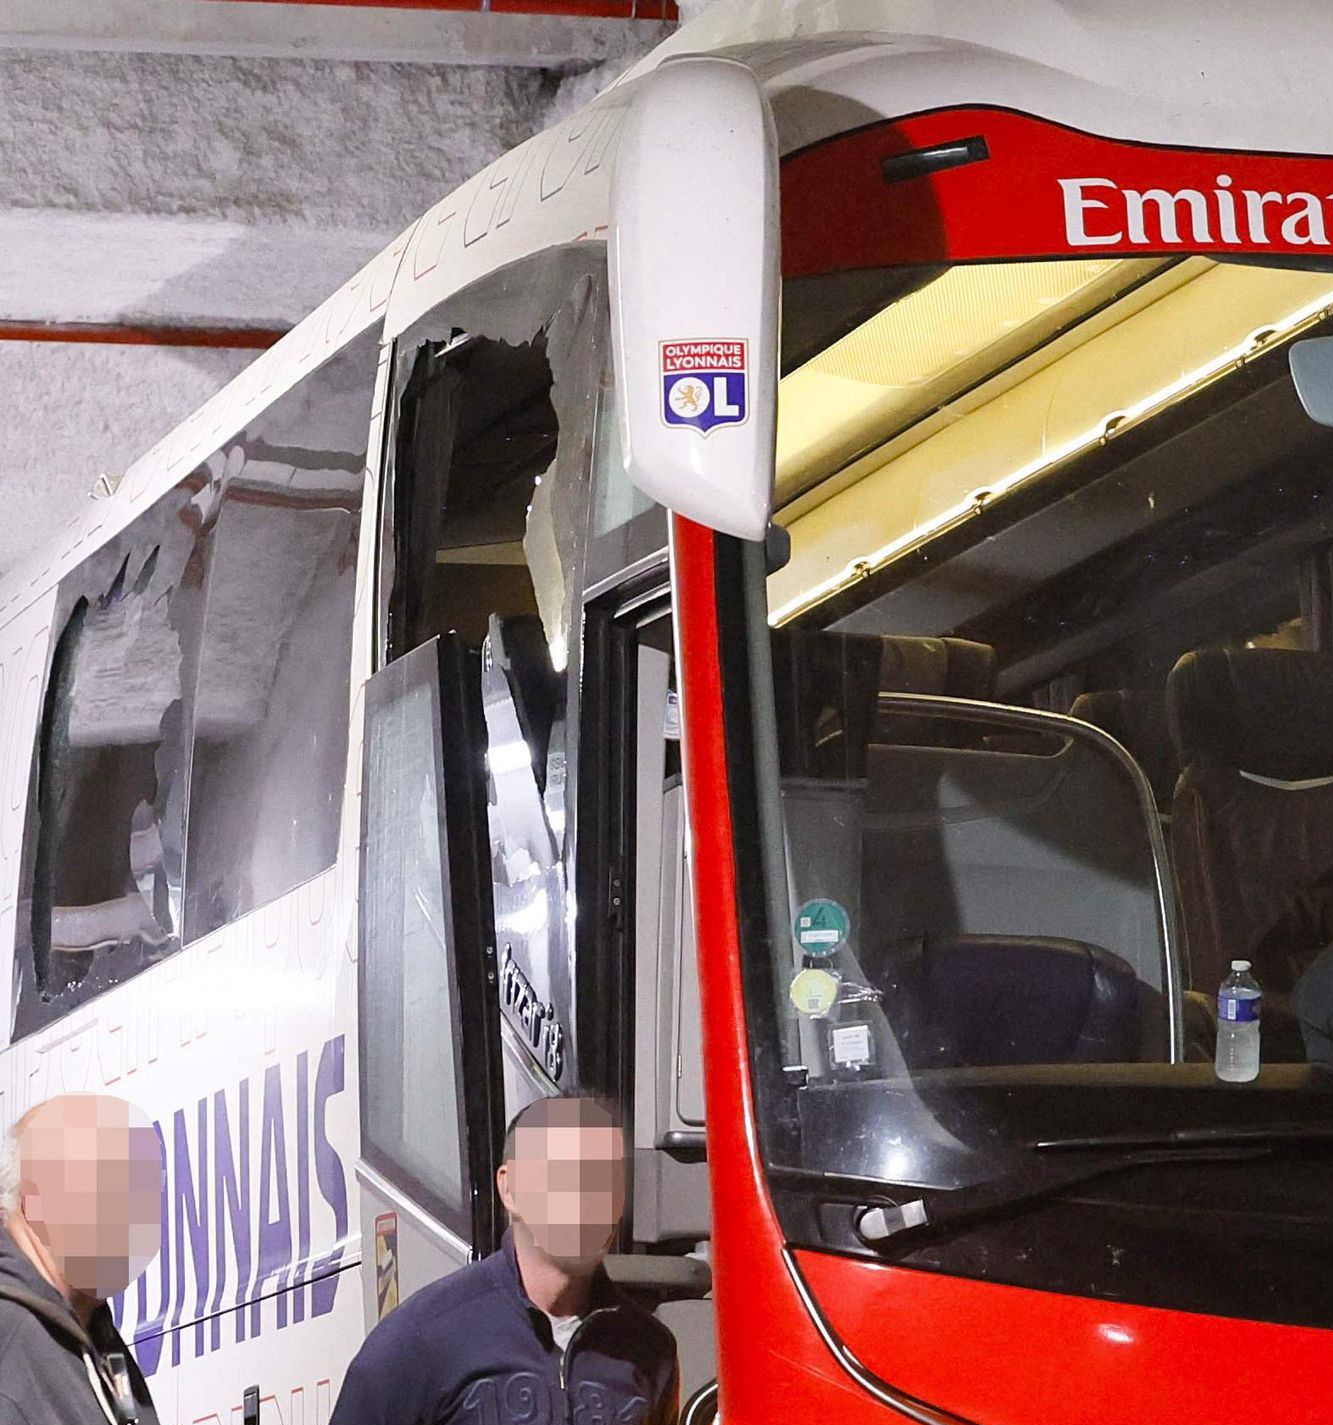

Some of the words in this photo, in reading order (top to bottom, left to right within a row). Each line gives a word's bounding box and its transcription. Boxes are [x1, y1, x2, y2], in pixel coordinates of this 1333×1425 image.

[665, 344, 741, 356] OLYMPIQUE
[666, 356, 742, 369] LYONNAIS
[668, 376, 739, 418] OL
